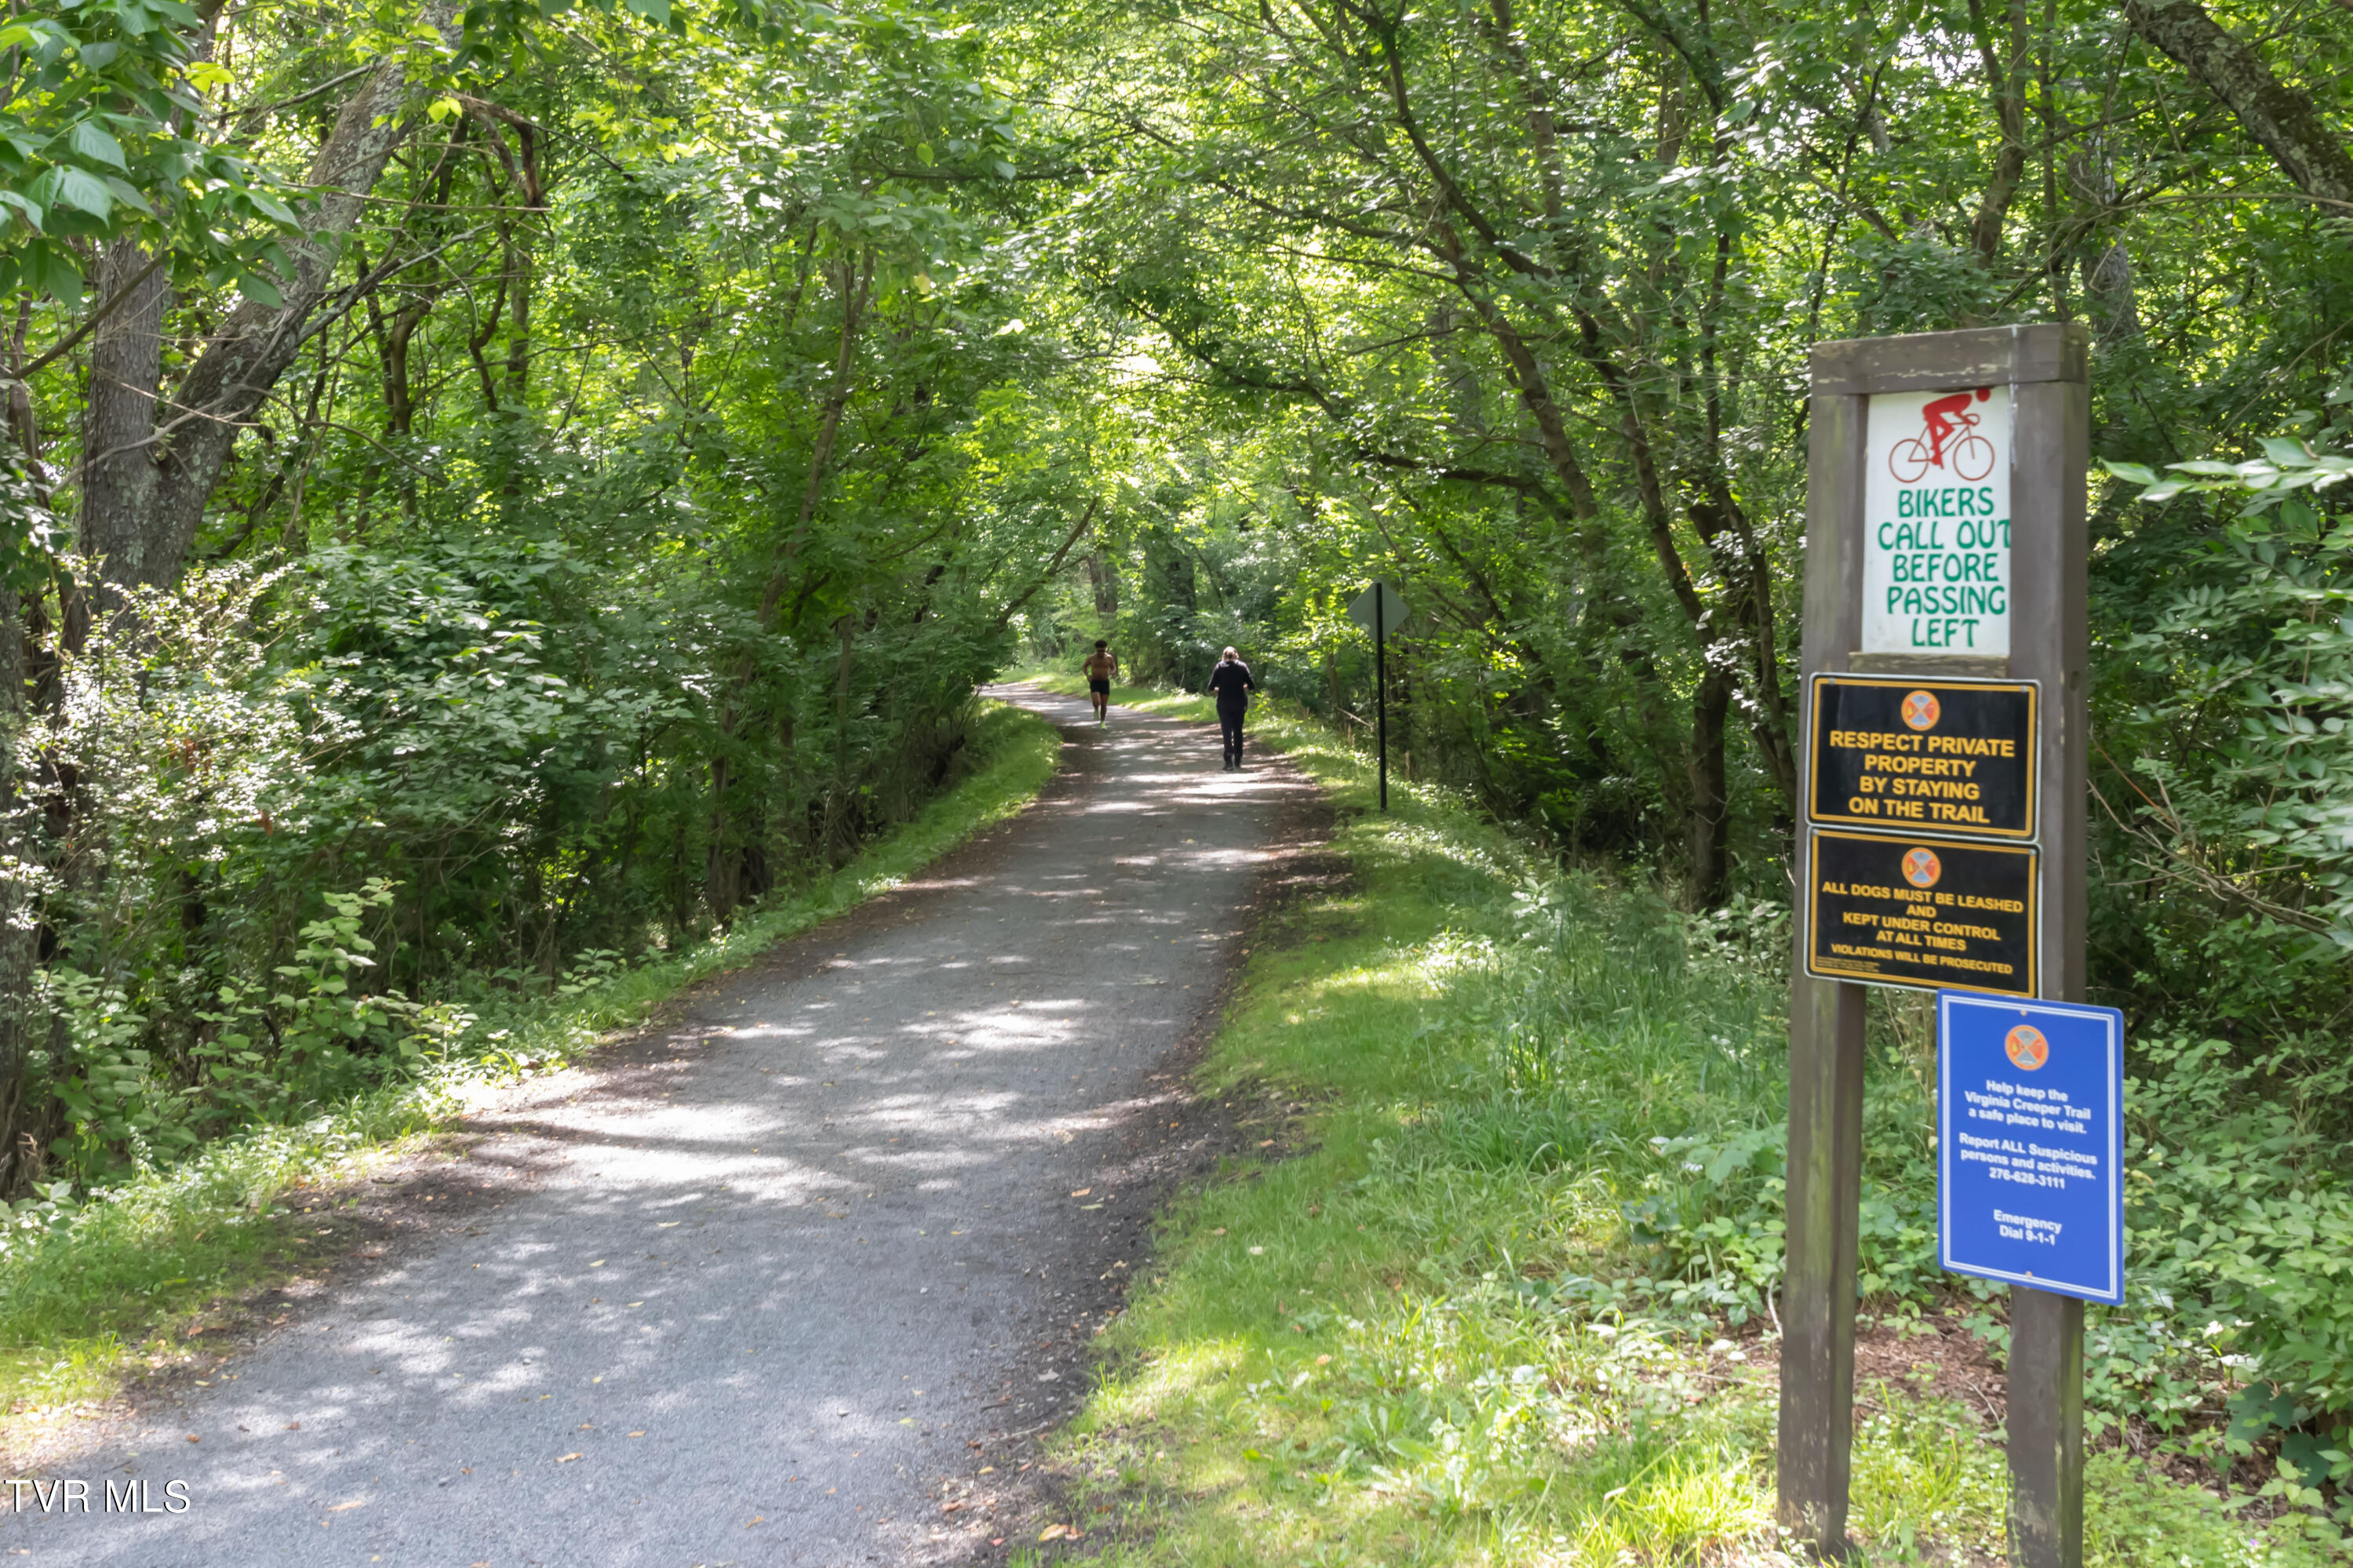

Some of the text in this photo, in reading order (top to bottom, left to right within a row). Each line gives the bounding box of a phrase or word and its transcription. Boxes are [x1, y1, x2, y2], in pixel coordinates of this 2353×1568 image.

[1898, 487, 1994, 518] BIKERS
[1878, 518, 2011, 550] CALL OUT
[1892, 553, 1999, 582] BEFORE
[1887, 586, 2005, 614] PASSING
[1912, 618, 1980, 647] LEFT
[1830, 730, 2015, 757] RESPECT PRIVATE
[1864, 755, 1976, 777] PROPERTY
[1859, 776, 1980, 799] BY STAYING
[1849, 797, 1990, 824] ON THE TRAIL
[1822, 882, 2023, 913] ALL DOGS MUST BE LEASHED
[1906, 905, 1936, 918] AND
[1843, 912, 2001, 940] KEPT UNDER CONTROL
[1876, 930, 1966, 951] AT ALL TIMES
[1831, 944, 2013, 973] VIOLATIONS WILL BE PROSECUTED
[1987, 1079, 2068, 1102] Help keep the
[1965, 1090, 2091, 1119] Virginia Creeper Trail
[1969, 1108, 2087, 1134] a safe place to visit.
[1959, 1133, 2097, 1165] Report ALL Suspicious
[1961, 1149, 2096, 1180] persons and activities.
[1989, 1167, 2065, 1189] 276-628-3111
[1994, 1210, 2062, 1234] Emergency
[2000, 1224, 2055, 1246] Dial 9-1-1
